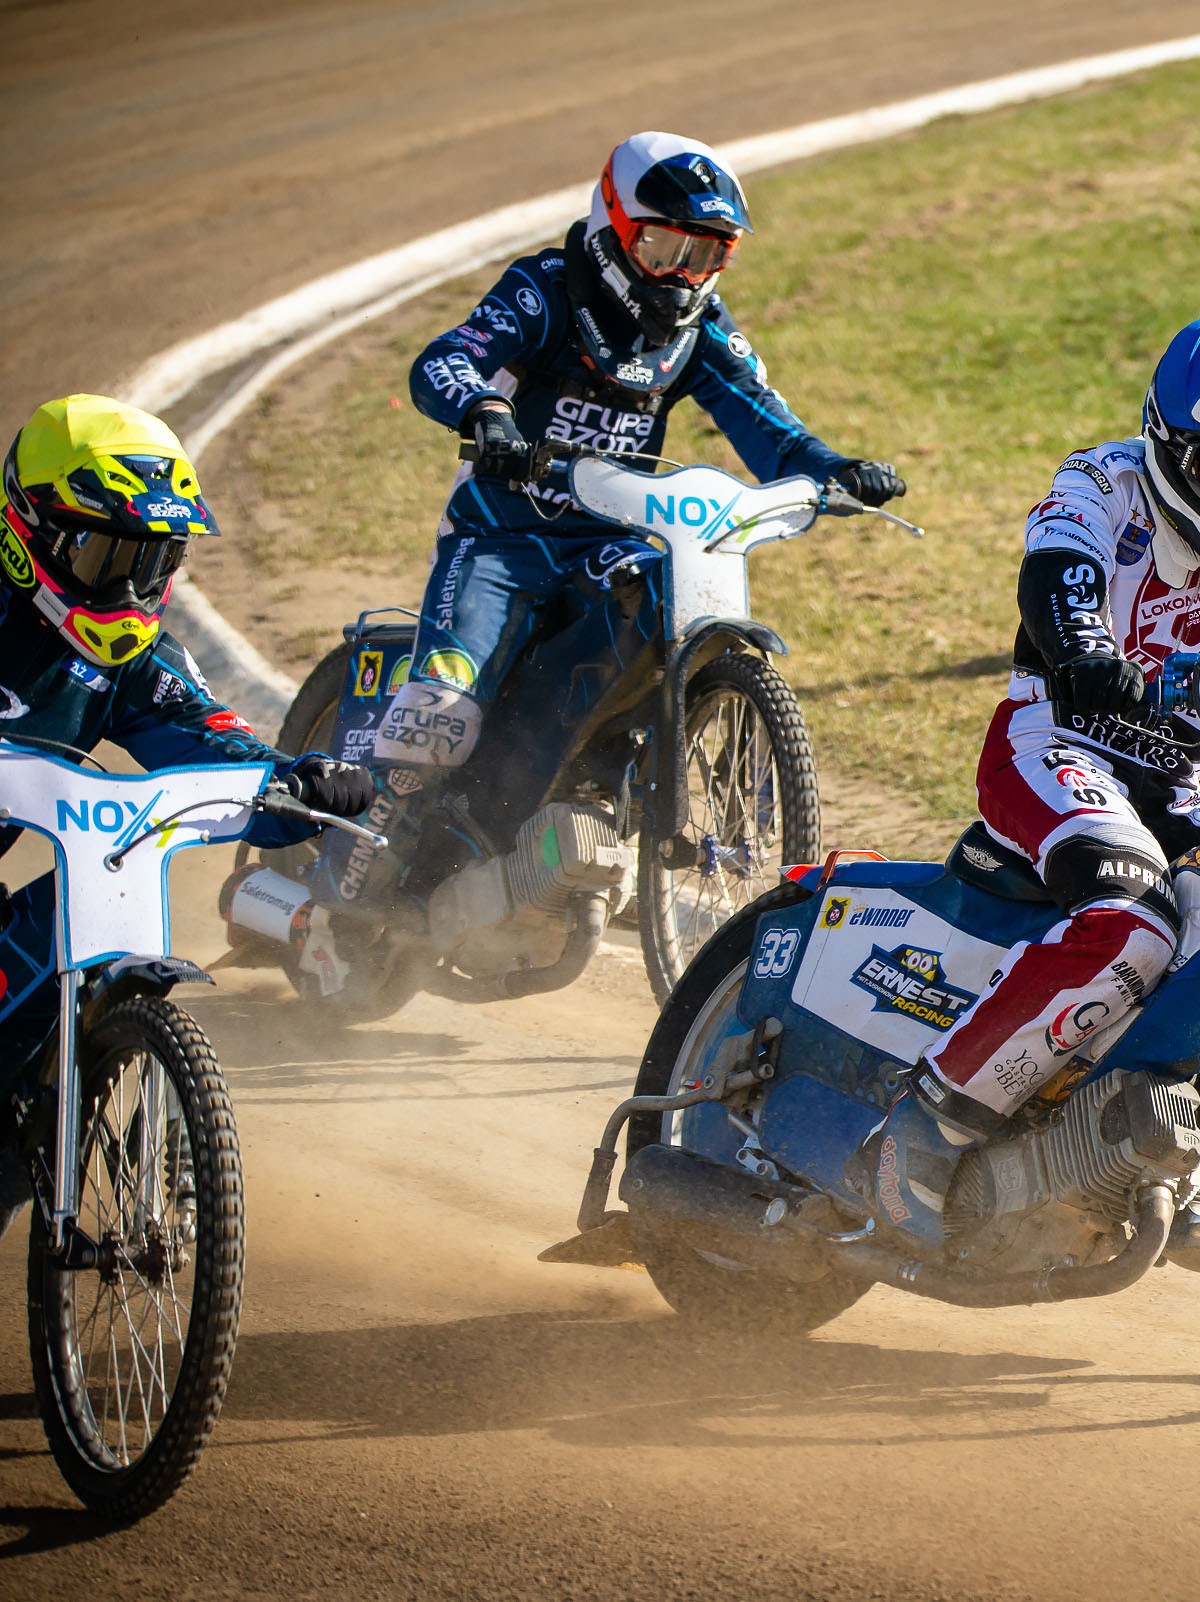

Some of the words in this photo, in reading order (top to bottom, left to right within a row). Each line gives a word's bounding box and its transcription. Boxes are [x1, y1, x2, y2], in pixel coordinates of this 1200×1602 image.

[239, 881, 297, 917] Saletromag
[754, 928, 802, 979] 33
[862, 957, 970, 1012] ERNEST
[892, 996, 956, 1029] RACING
